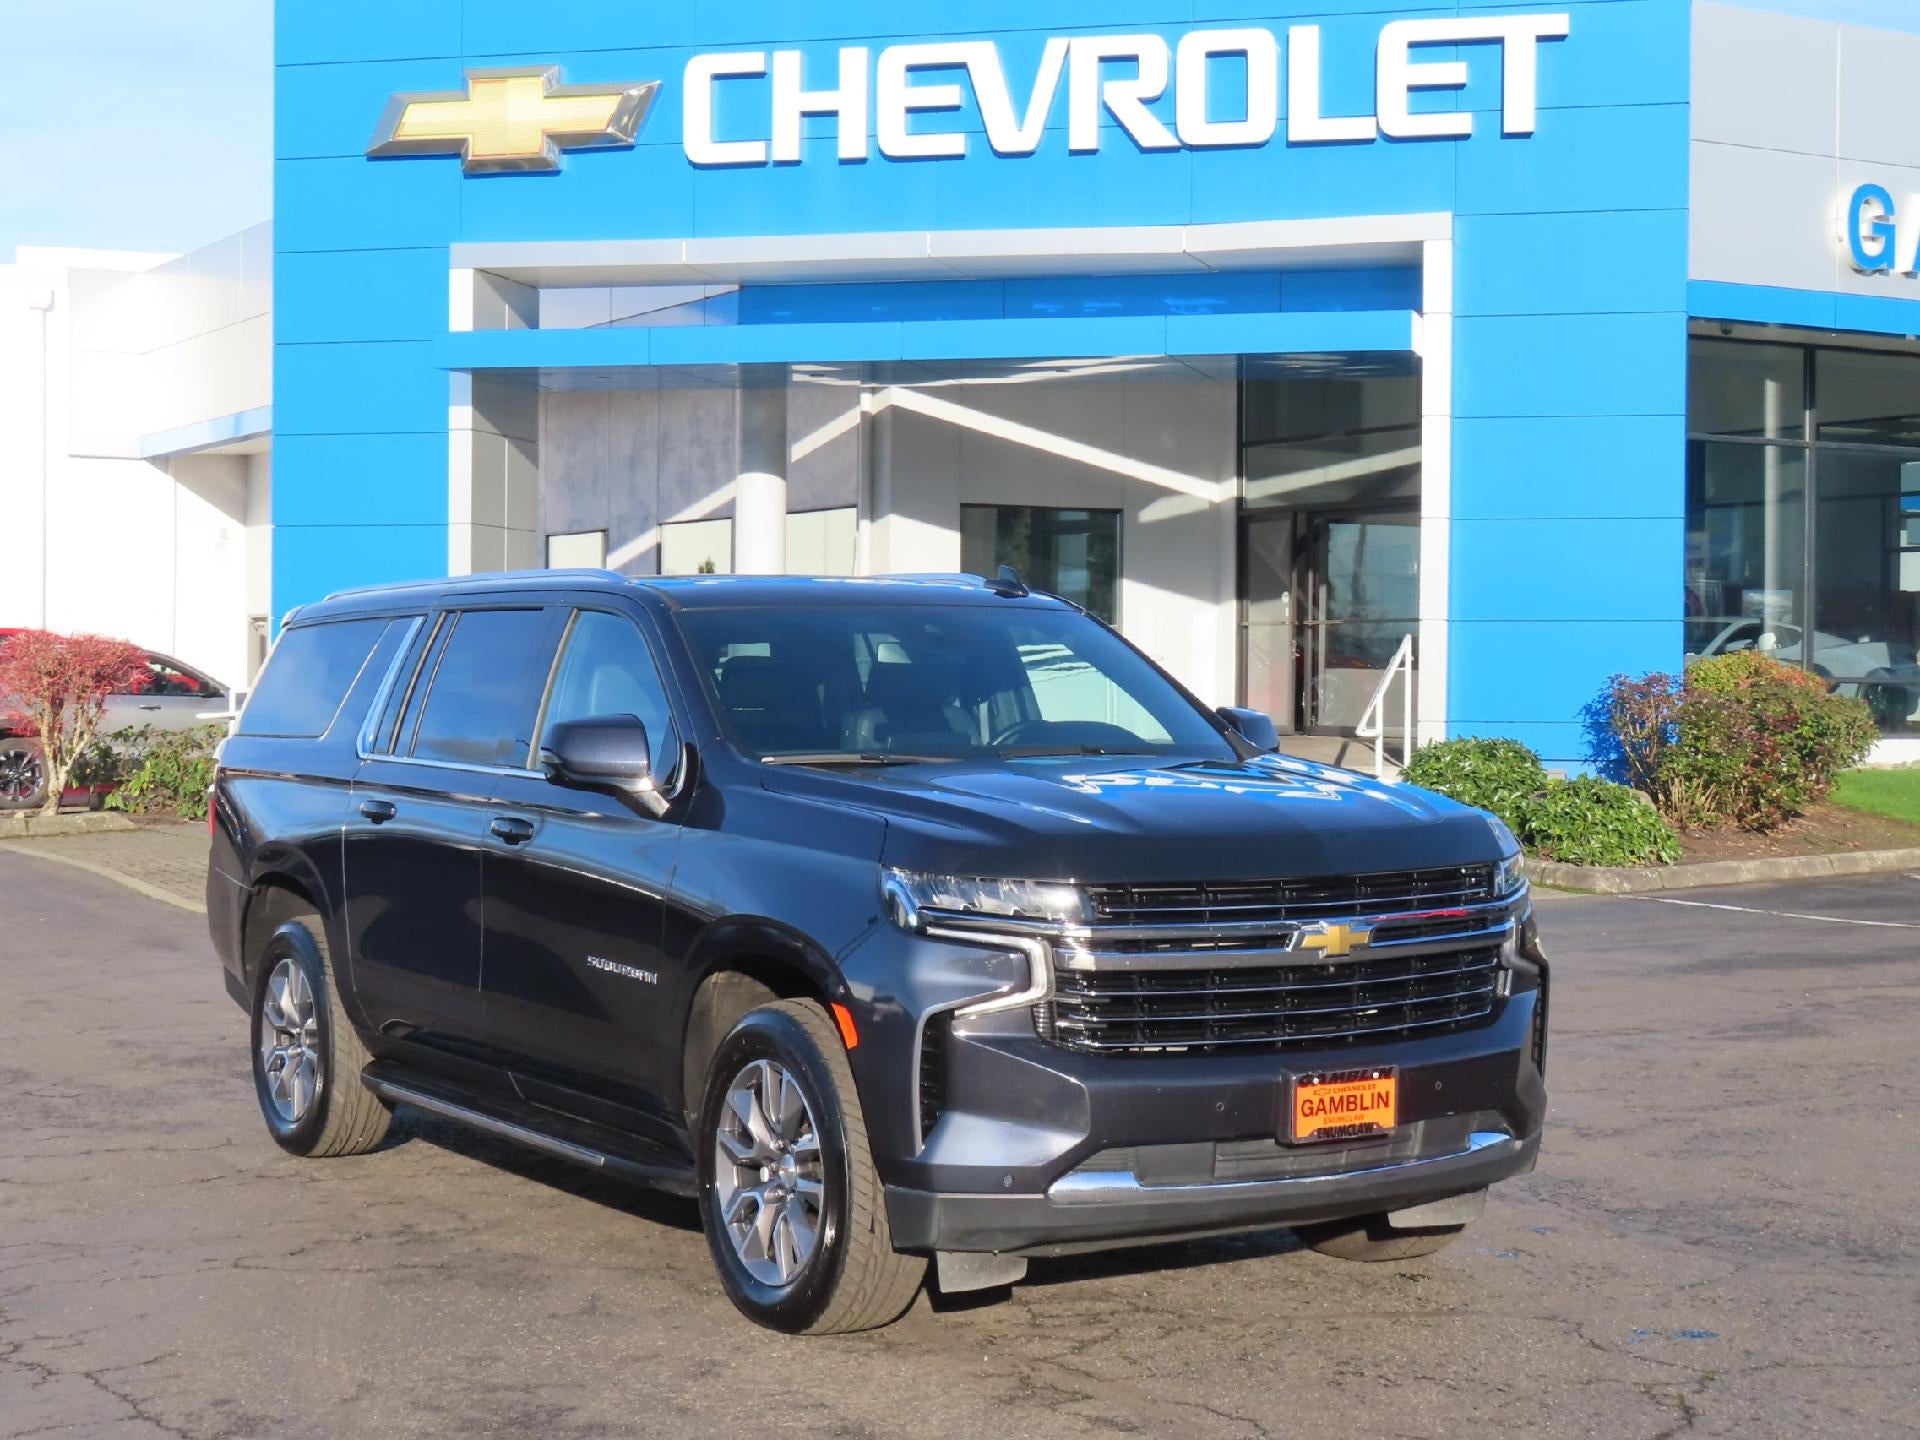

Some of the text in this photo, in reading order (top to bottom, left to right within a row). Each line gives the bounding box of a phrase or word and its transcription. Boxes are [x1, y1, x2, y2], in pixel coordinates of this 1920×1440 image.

[682, 12, 1570, 167] CHEVROLET
[1847, 183, 1920, 272] G
[1301, 1090, 1390, 1118] GAMBLIN
[1317, 1122, 1374, 1139] ENUMCLAW
